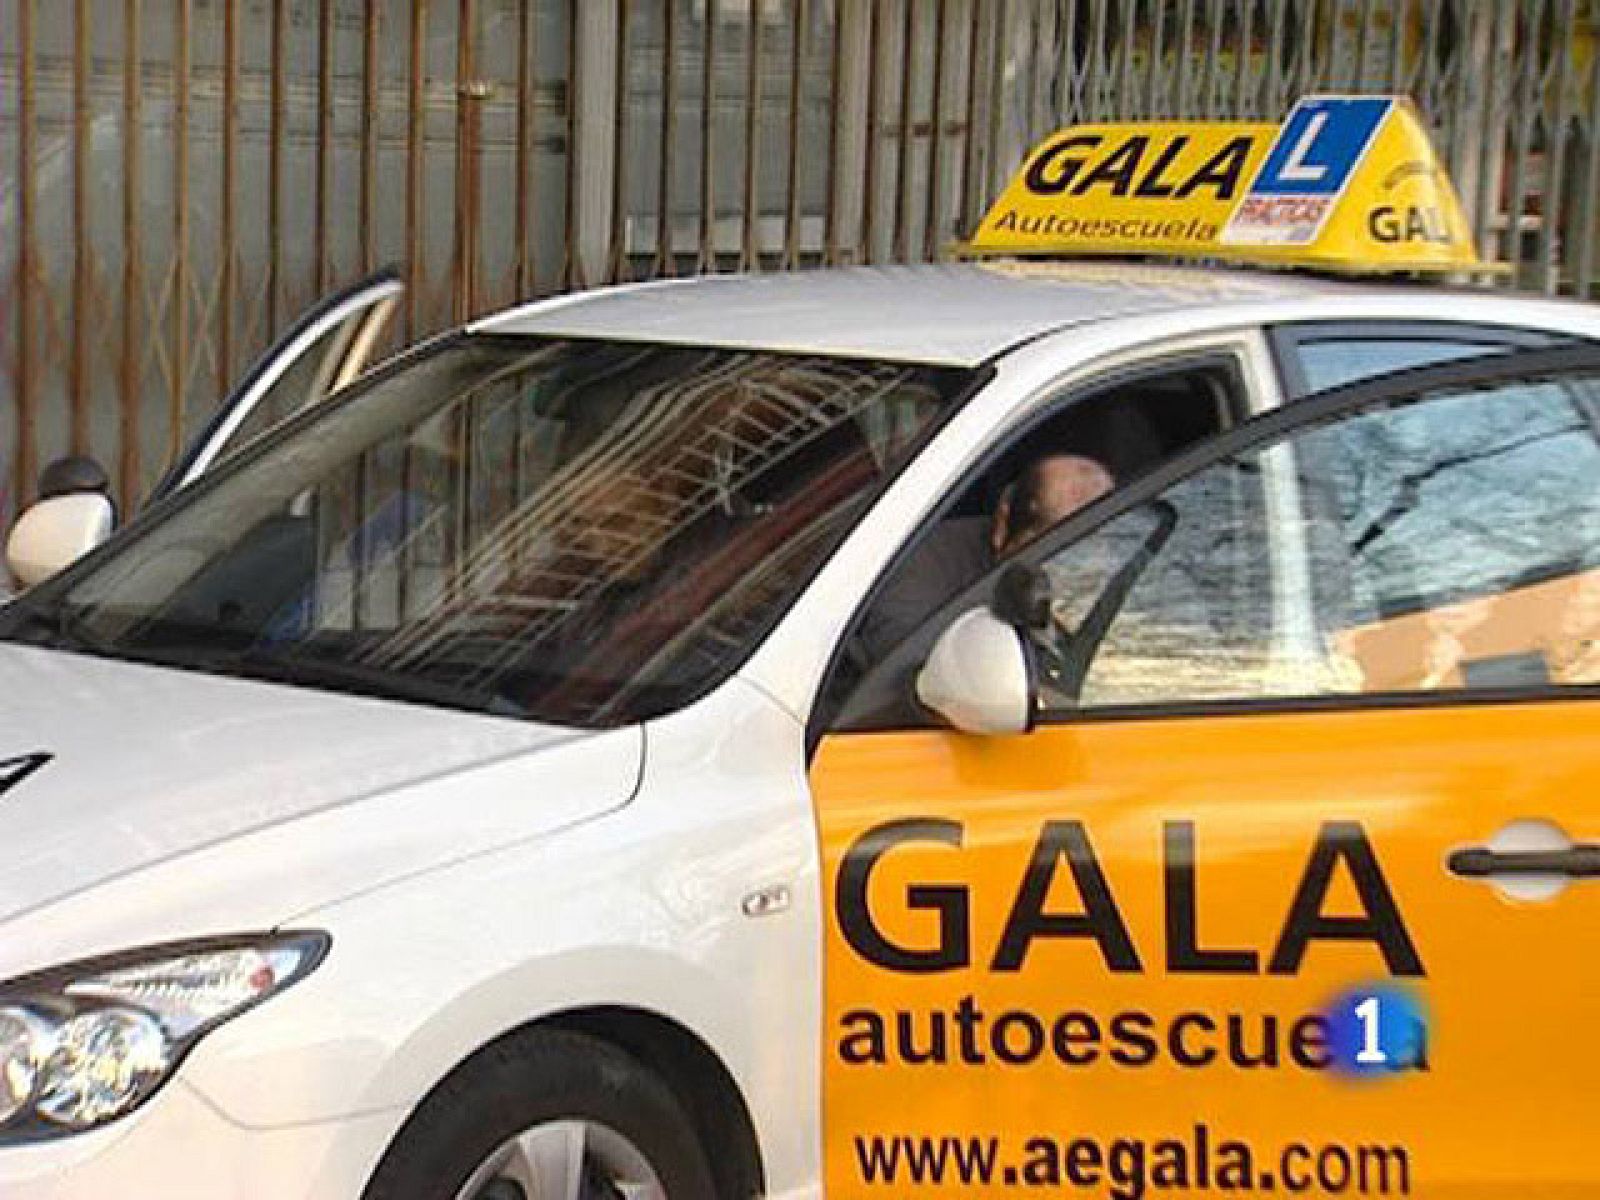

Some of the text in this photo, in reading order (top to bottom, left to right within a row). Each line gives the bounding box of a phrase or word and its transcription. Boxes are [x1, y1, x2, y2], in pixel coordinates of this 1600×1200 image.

[1025, 134, 1254, 199] GALA
[1279, 111, 1331, 180] L
[994, 209, 1217, 241] Autoescuela
[835, 817, 1425, 976] GALA
[855, 1125, 1410, 1200] www.aegala.com
